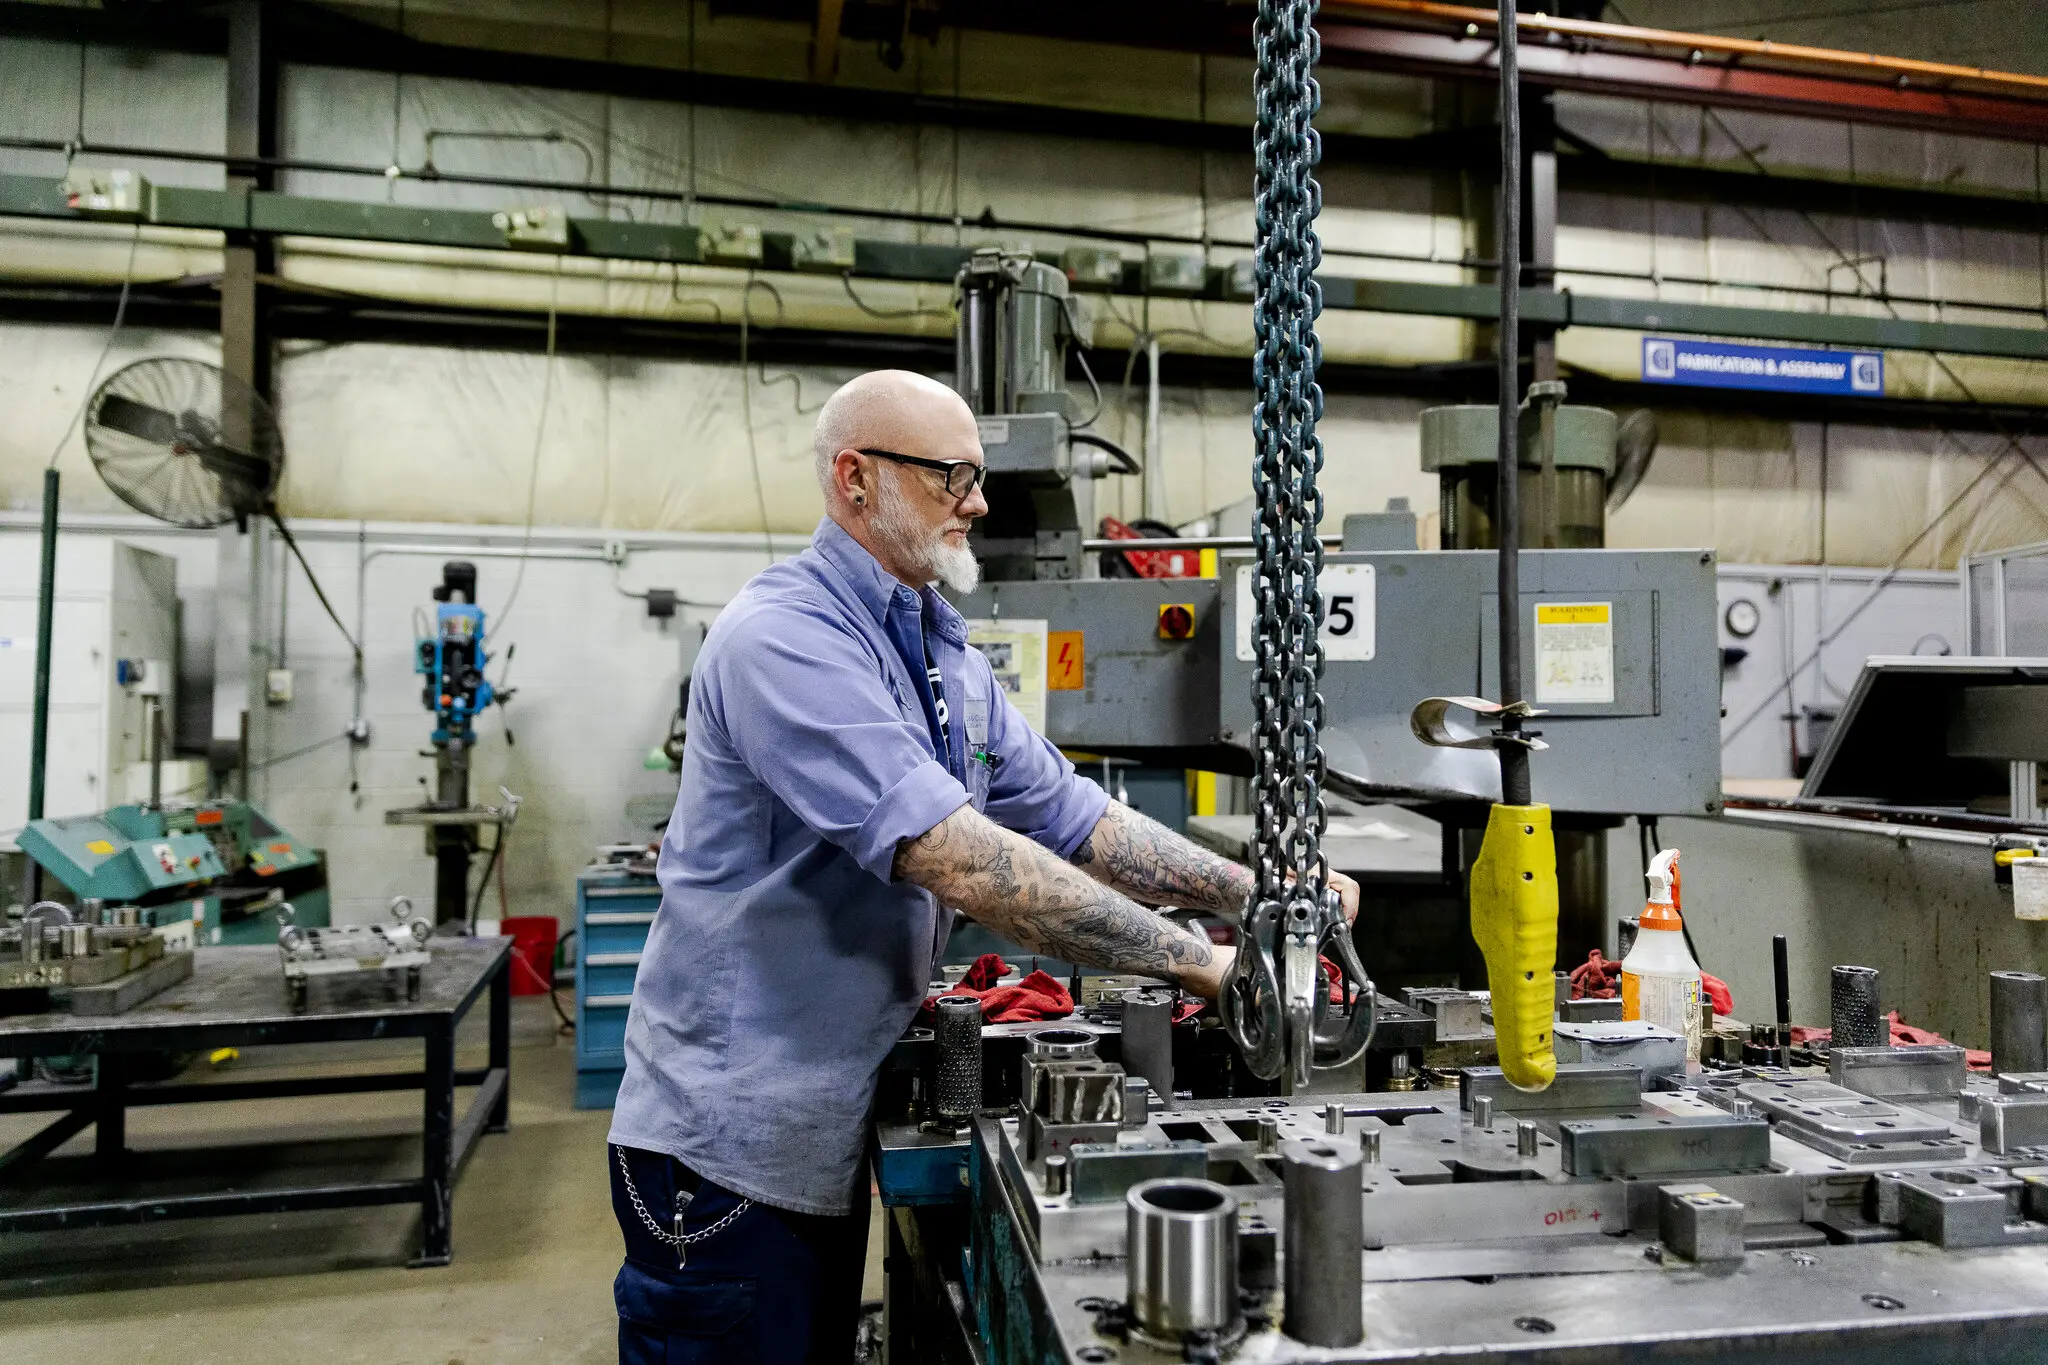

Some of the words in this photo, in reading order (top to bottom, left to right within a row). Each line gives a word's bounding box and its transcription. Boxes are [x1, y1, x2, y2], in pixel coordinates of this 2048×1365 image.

[1677, 352, 1765, 375] FABRICATION
[1765, 358, 1778, 376] &
[1779, 360, 1846, 380] ASSEMBLY
